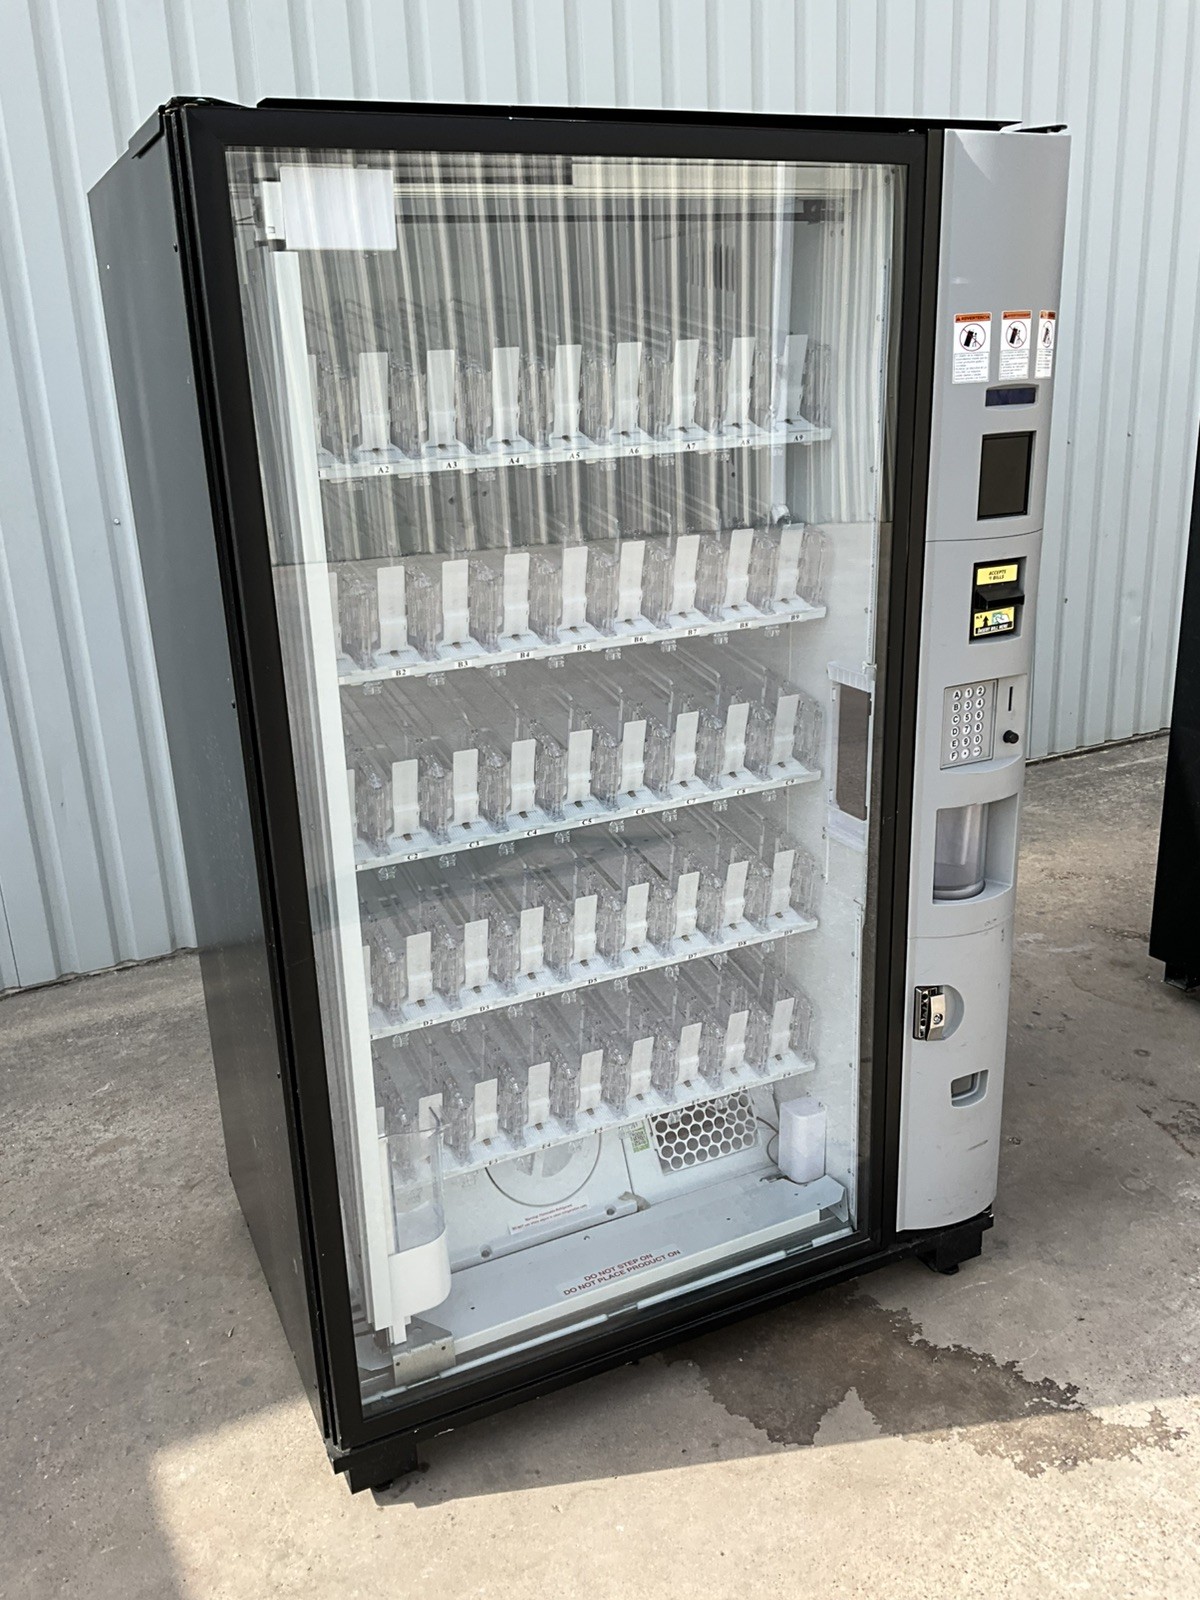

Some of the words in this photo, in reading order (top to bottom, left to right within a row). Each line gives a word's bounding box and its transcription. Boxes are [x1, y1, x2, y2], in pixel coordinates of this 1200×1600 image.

[378, 465, 390, 474] A2
[446, 461, 458, 469] A3
[509, 456, 520, 464] A4
[570, 452, 580, 460] A5
[628, 446, 640, 454] A6
[685, 442, 696, 450] A7
[564, 1287, 578, 1296] DO
[578, 1280, 596, 1291] NOT
[598, 1270, 627, 1283] PLACE
[627, 1255, 667, 1273] PRODUCT
[667, 1249, 681, 1258] ON
[584, 1273, 598, 1281] DO
[598, 1266, 616, 1277] NOT
[617, 1258, 639, 1269] STEP
[640, 1253, 654, 1262] ON
